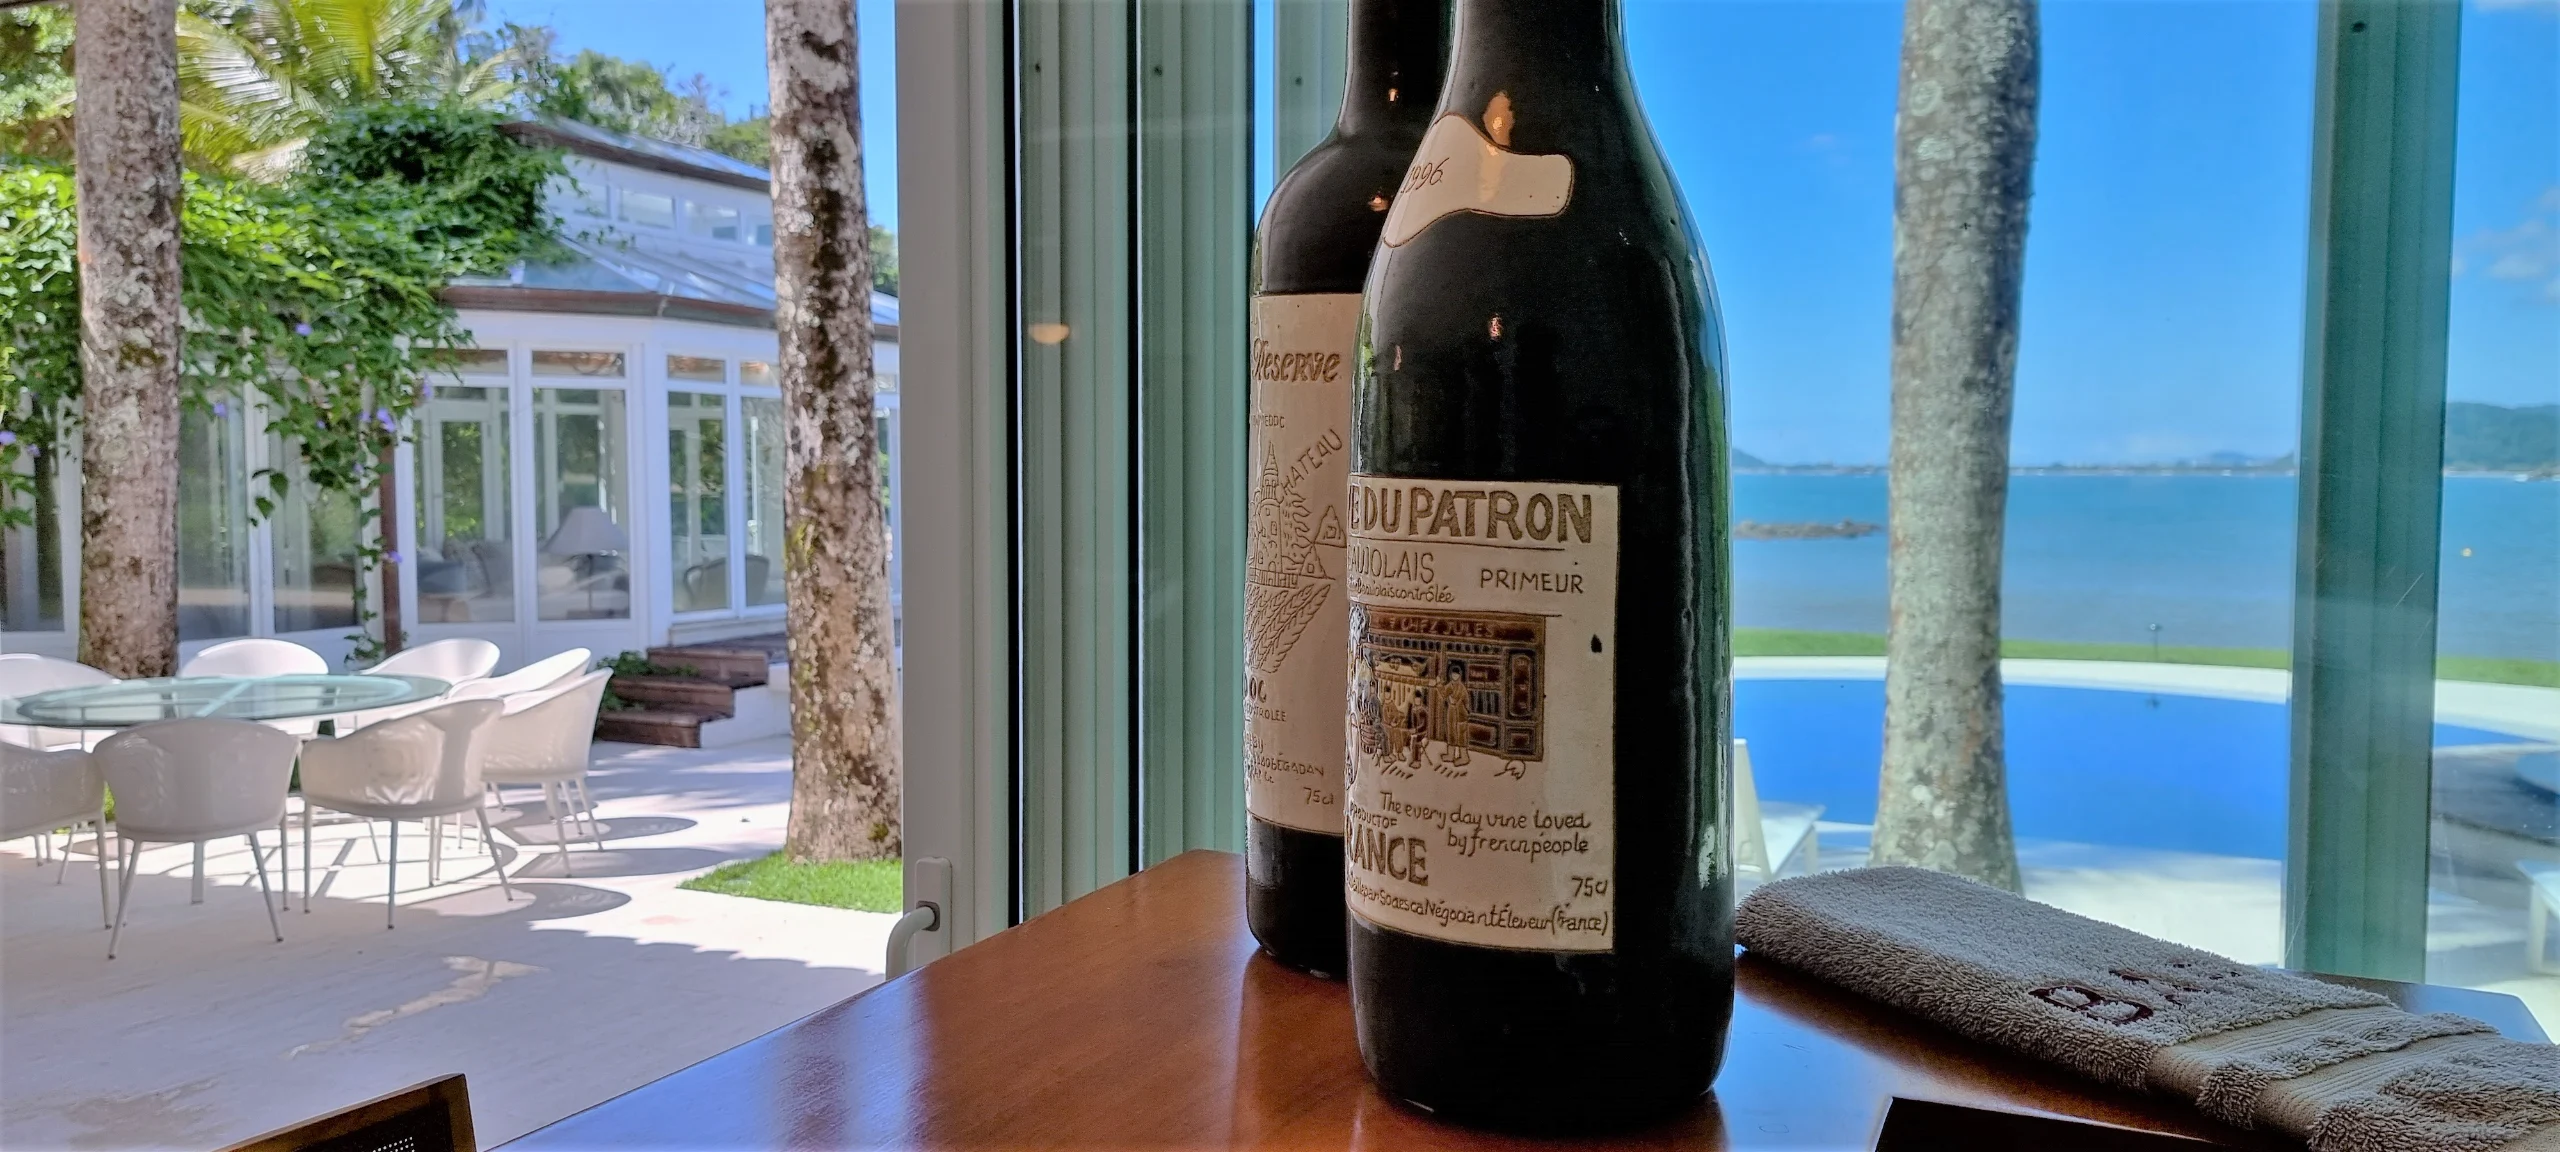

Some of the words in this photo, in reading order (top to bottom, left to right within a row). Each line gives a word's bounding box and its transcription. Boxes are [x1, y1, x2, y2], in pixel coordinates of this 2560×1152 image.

[1364, 486, 1402, 533] DU
[1408, 486, 1592, 543] PATRON
[1480, 568, 1584, 594] PRIMEUR
[1442, 621, 1494, 638] JULES
[1381, 790, 1401, 814] The
[1405, 803, 1447, 830] every
[1450, 804, 1482, 832] day
[1535, 808, 1592, 829] loved
